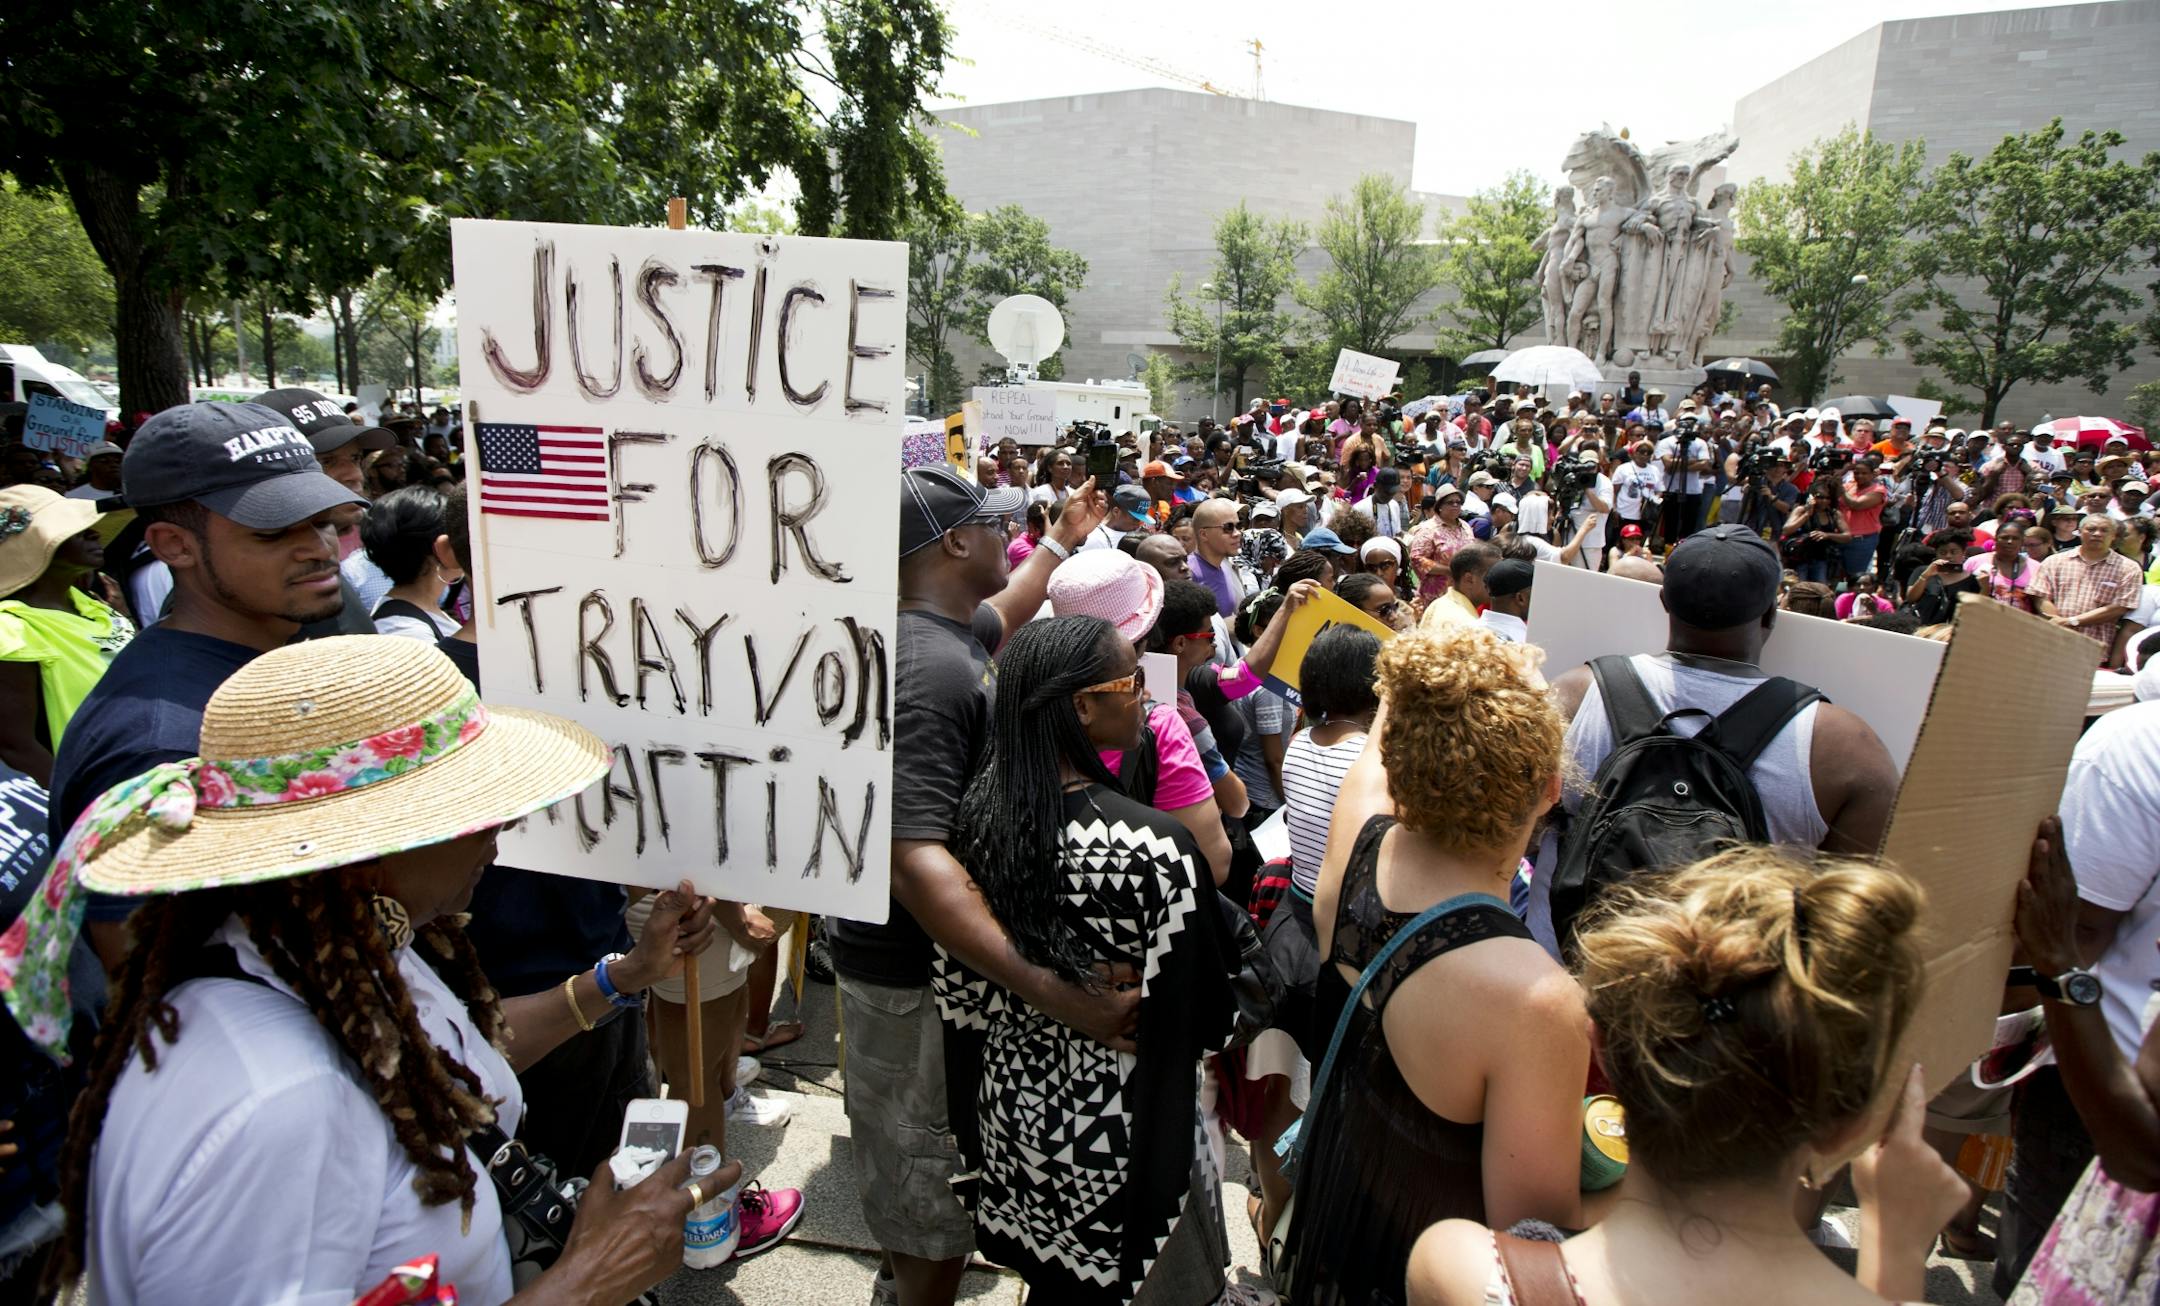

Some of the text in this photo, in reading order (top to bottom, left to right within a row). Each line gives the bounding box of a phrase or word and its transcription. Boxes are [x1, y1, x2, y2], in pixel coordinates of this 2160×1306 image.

[991, 390, 1036, 405] REPEAL
[291, 404, 317, 425] 95
[608, 428, 854, 585] FOR
